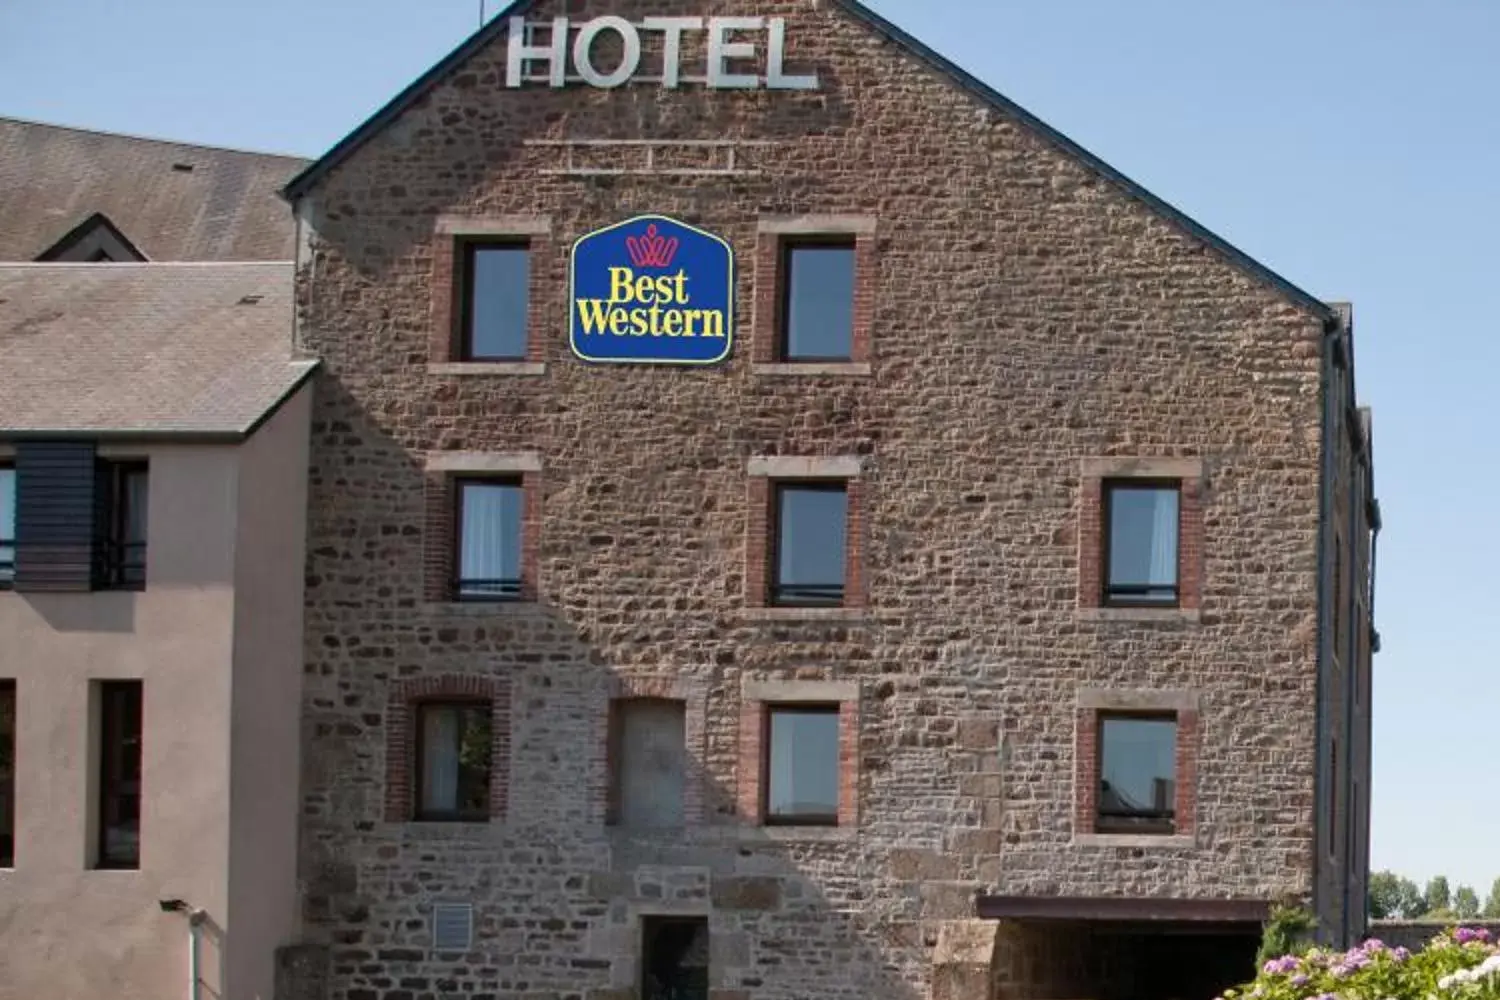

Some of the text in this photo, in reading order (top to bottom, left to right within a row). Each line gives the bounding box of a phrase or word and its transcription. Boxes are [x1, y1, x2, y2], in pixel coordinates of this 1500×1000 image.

[505, 15, 819, 89] HOTEL
[608, 267, 689, 305] Best
[576, 298, 725, 337] Western
